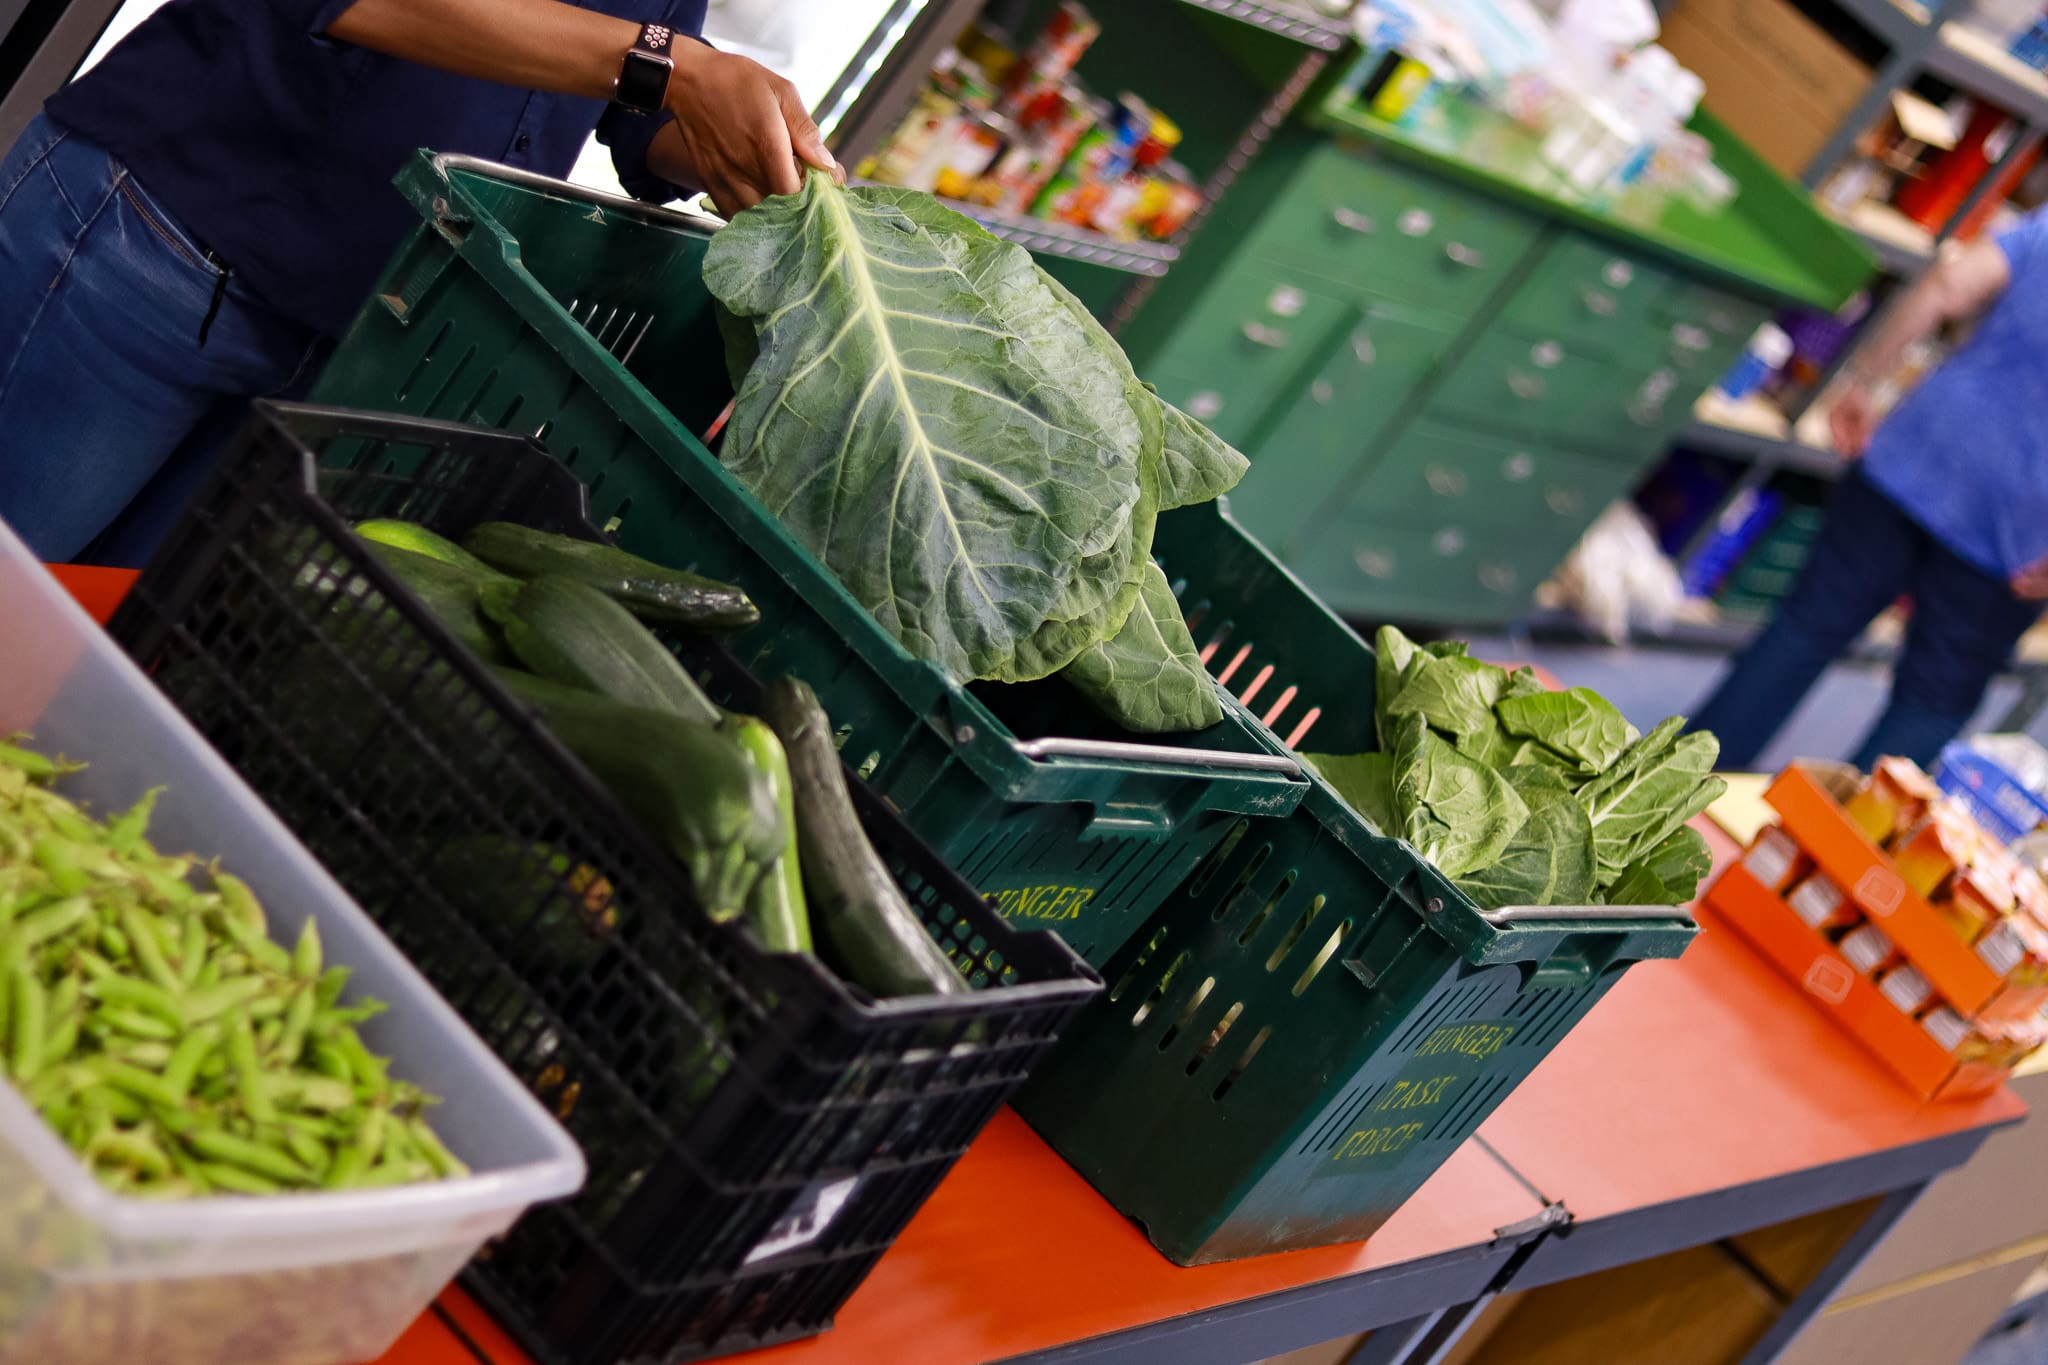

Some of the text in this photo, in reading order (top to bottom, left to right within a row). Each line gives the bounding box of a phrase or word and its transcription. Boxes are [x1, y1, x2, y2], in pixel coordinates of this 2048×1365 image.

[981, 885, 1094, 920] UNGER
[1414, 1024, 1515, 1057] HUNGER
[1376, 1076, 1457, 1112] TASK
[1333, 1122, 1424, 1161] FORCE
